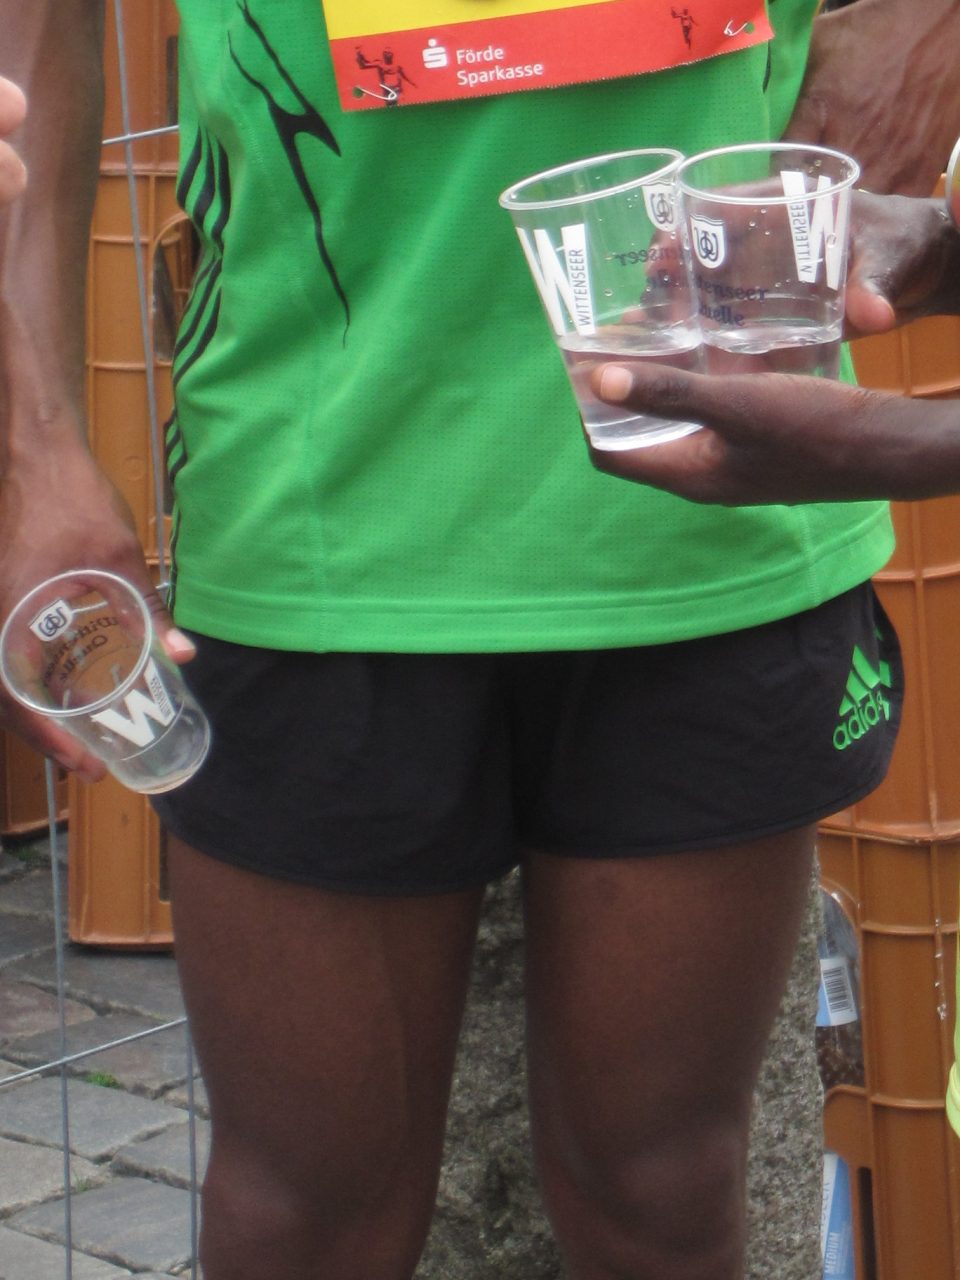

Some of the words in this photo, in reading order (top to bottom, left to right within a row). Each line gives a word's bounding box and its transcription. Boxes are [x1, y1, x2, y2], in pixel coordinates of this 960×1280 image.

[456, 44, 505, 66] Förde
[456, 61, 544, 87] Sparkasse
[565, 247, 590, 328] WITTENSEER
[833, 689, 885, 751] adid
